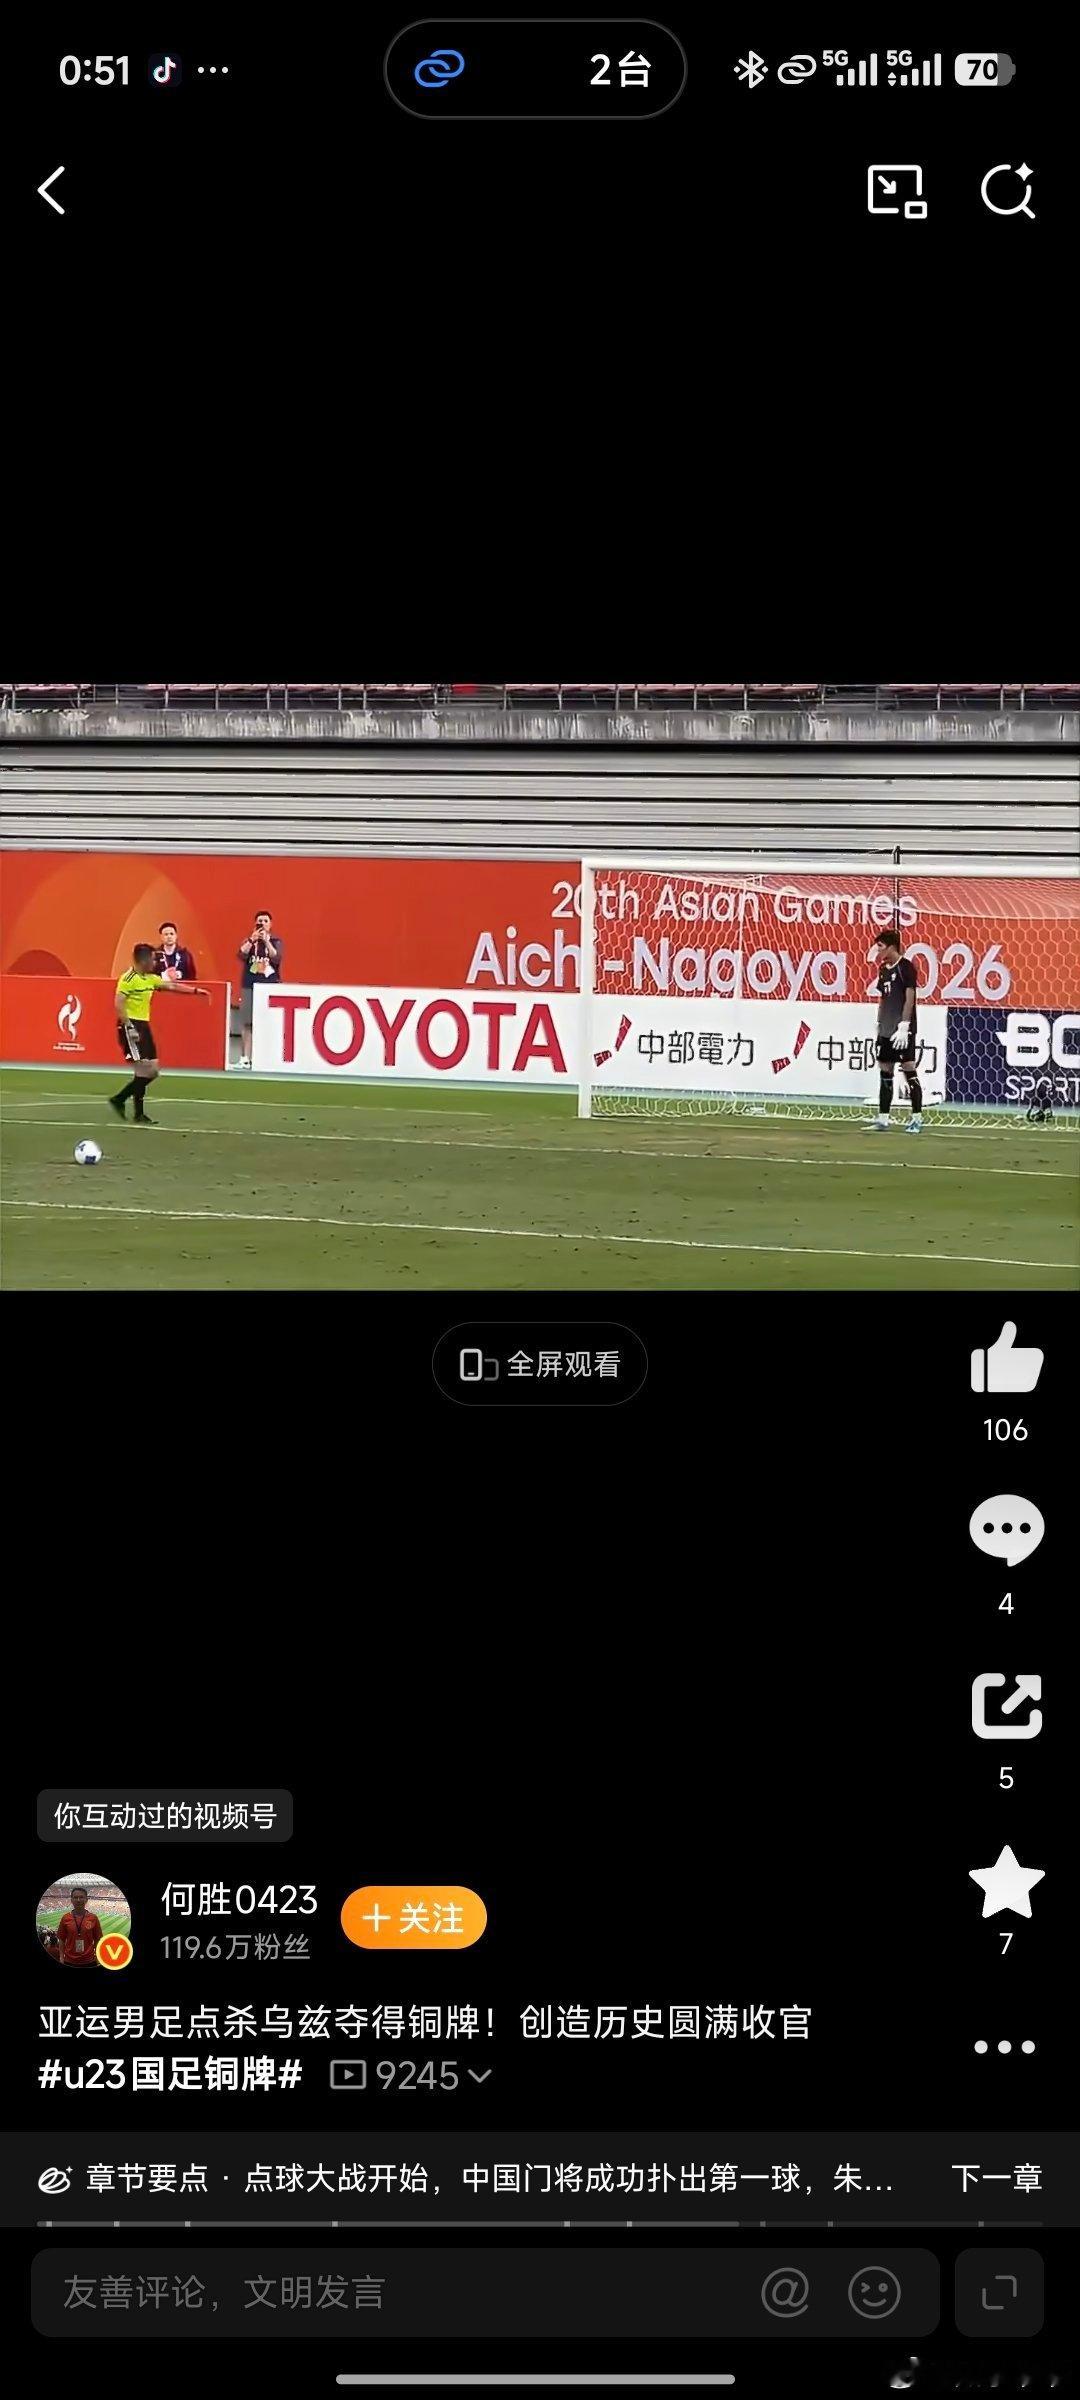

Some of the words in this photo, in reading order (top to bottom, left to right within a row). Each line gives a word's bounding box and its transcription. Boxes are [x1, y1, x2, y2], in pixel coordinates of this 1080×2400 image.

[59, 54, 129, 86] 0:51
[590, 50, 652, 88] 2台
[822, 49, 849, 66] 5G
[886, 49, 913, 66] 5G
[967, 59, 998, 80] 70
[652, 883, 760, 923] Asian
[773, 885, 917, 927] Games
[465, 925, 847, 1001] Aich-Nagoya
[268, 995, 568, 1073] TOYOTA
[638, 1029, 754, 1067] 中部電力
[817, 1035, 938, 1074] 中部力
[506, 1350, 621, 1378] 全屏观看
[983, 1418, 1028, 1442] 106
[997, 1593, 1015, 1615] 4
[999, 1766, 1015, 1790] 5
[53, 1802, 278, 1830] 你互动过的视频号
[160, 1881, 318, 1917] 何胜0423
[160, 1933, 311, 1961] 119.6万粉丝
[999, 1932, 1014, 1955] 7
[37, 2055, 303, 2092] #u23国足铜牌#
[375, 2061, 459, 2091] 9245
[86, 2163, 209, 2194] 章节要点
[951, 2163, 1043, 2194] 下一章
